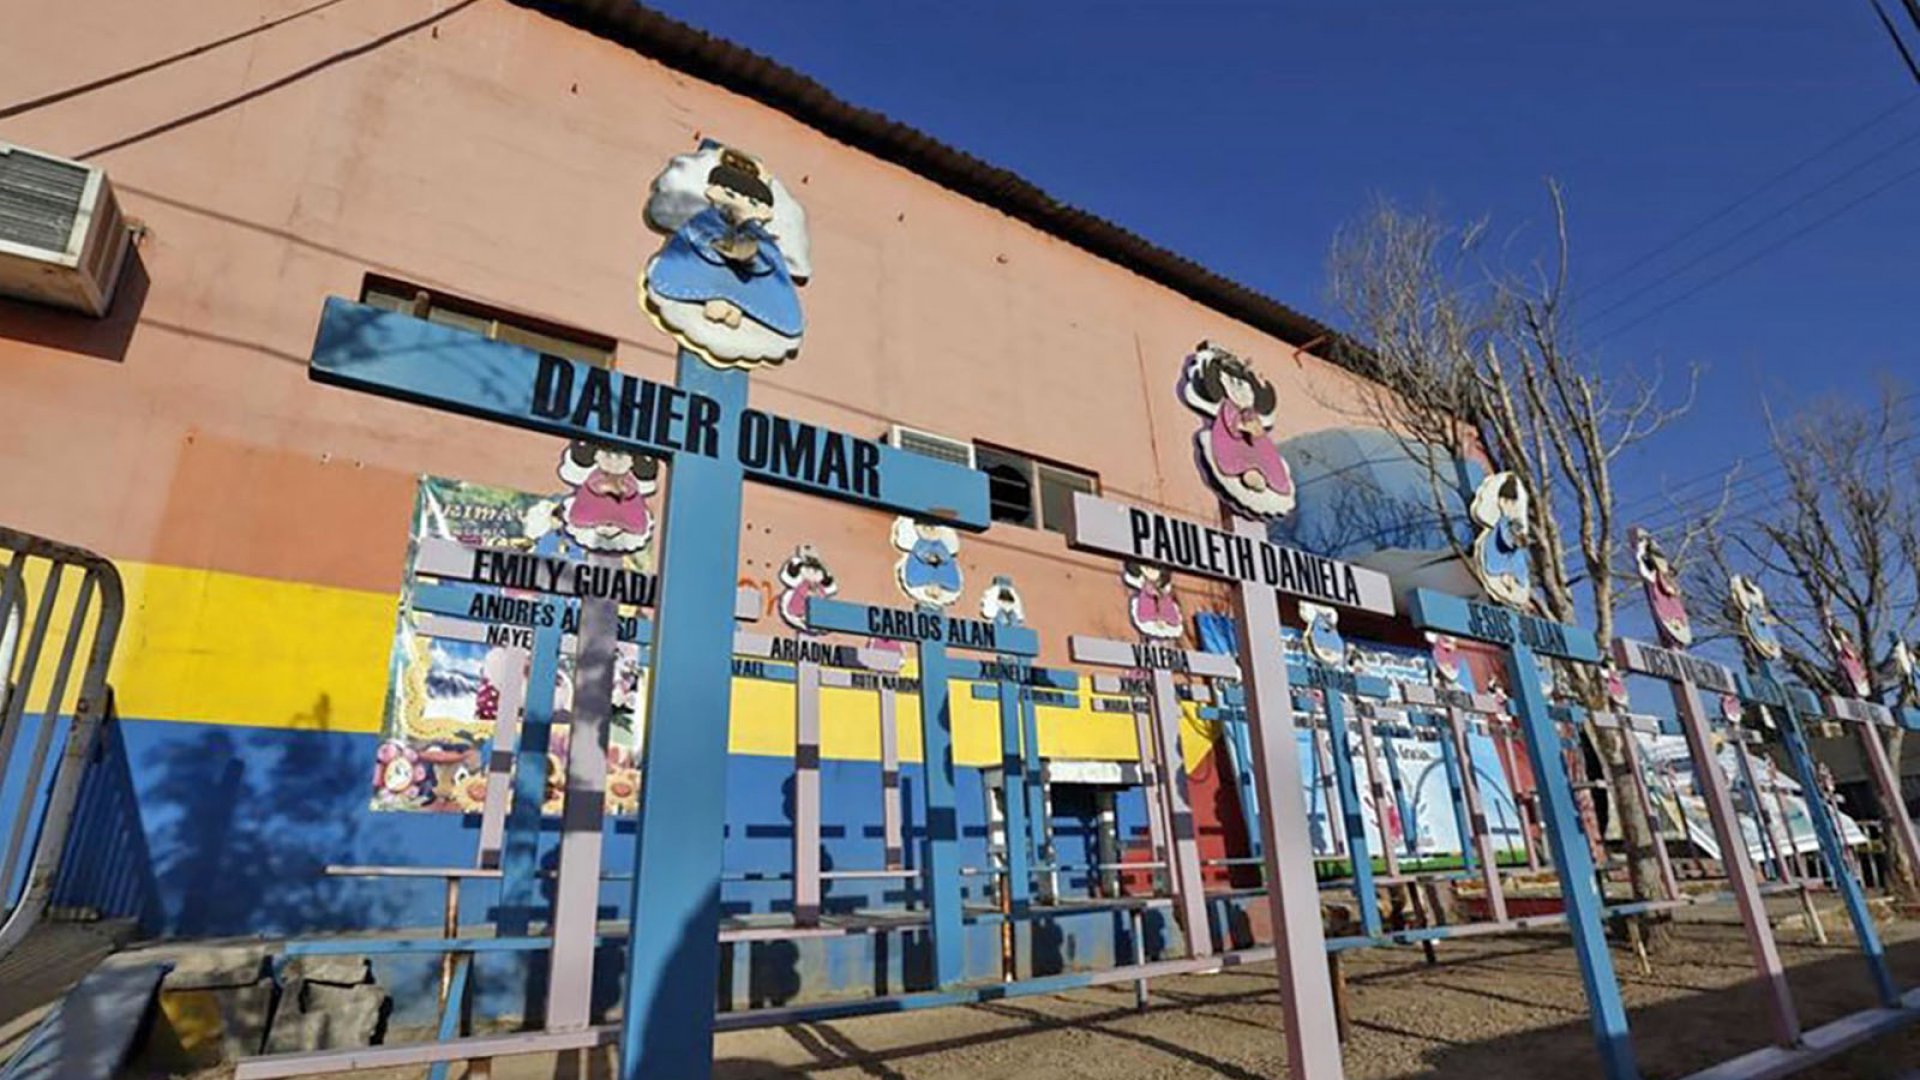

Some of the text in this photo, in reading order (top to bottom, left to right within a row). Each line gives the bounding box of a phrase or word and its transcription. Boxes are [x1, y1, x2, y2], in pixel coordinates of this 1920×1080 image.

[530, 352, 881, 498] DAHER OMAR
[472, 550, 567, 595] EMILY
[1129, 507, 1361, 606] PAULETH DANIELA
[468, 592, 555, 628] ANDRES
[868, 606, 996, 648] CARLOS ALAN
[1467, 602, 1516, 643] JESUS
[486, 625, 533, 649] NAYE
[769, 637, 844, 667] ARIADNA
